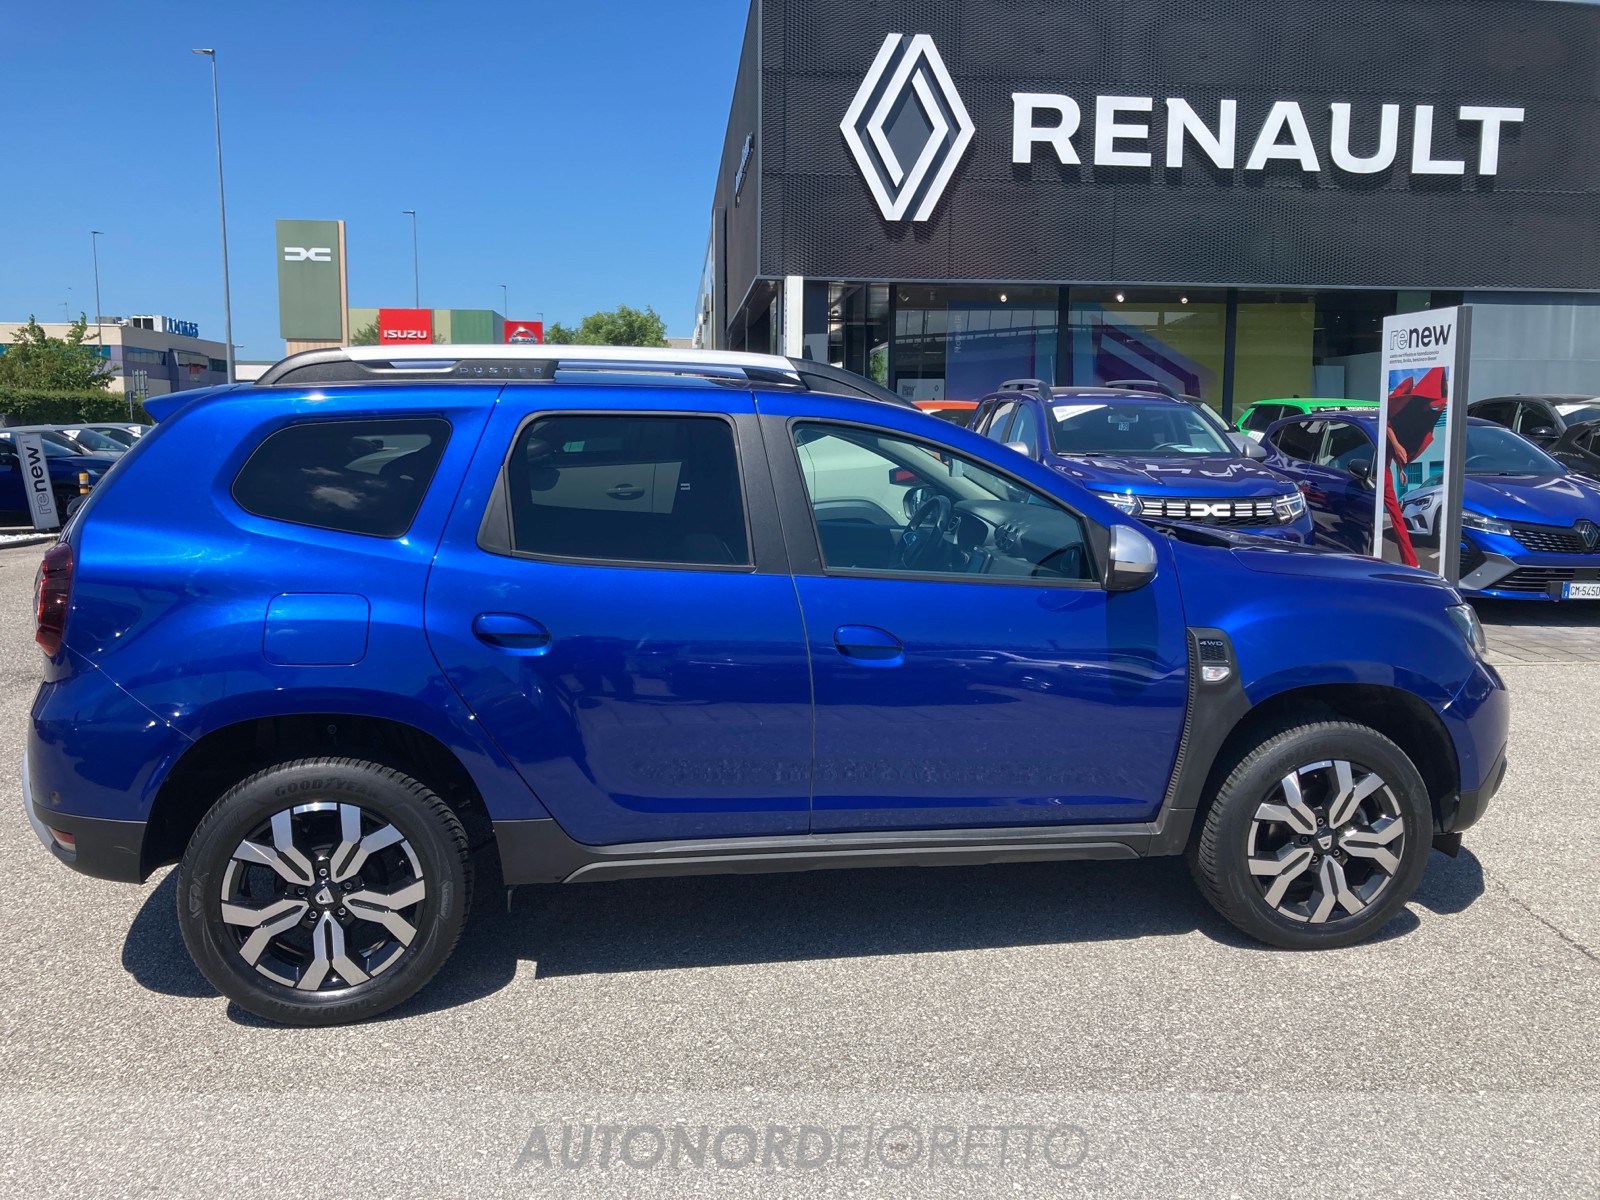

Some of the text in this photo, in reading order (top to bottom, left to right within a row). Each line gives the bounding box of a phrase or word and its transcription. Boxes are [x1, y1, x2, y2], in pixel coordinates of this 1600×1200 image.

[1012, 92, 1525, 175] RENAULT
[384, 330, 427, 338] ISUZU
[1390, 324, 1452, 350] renew
[26, 447, 52, 514] renew
